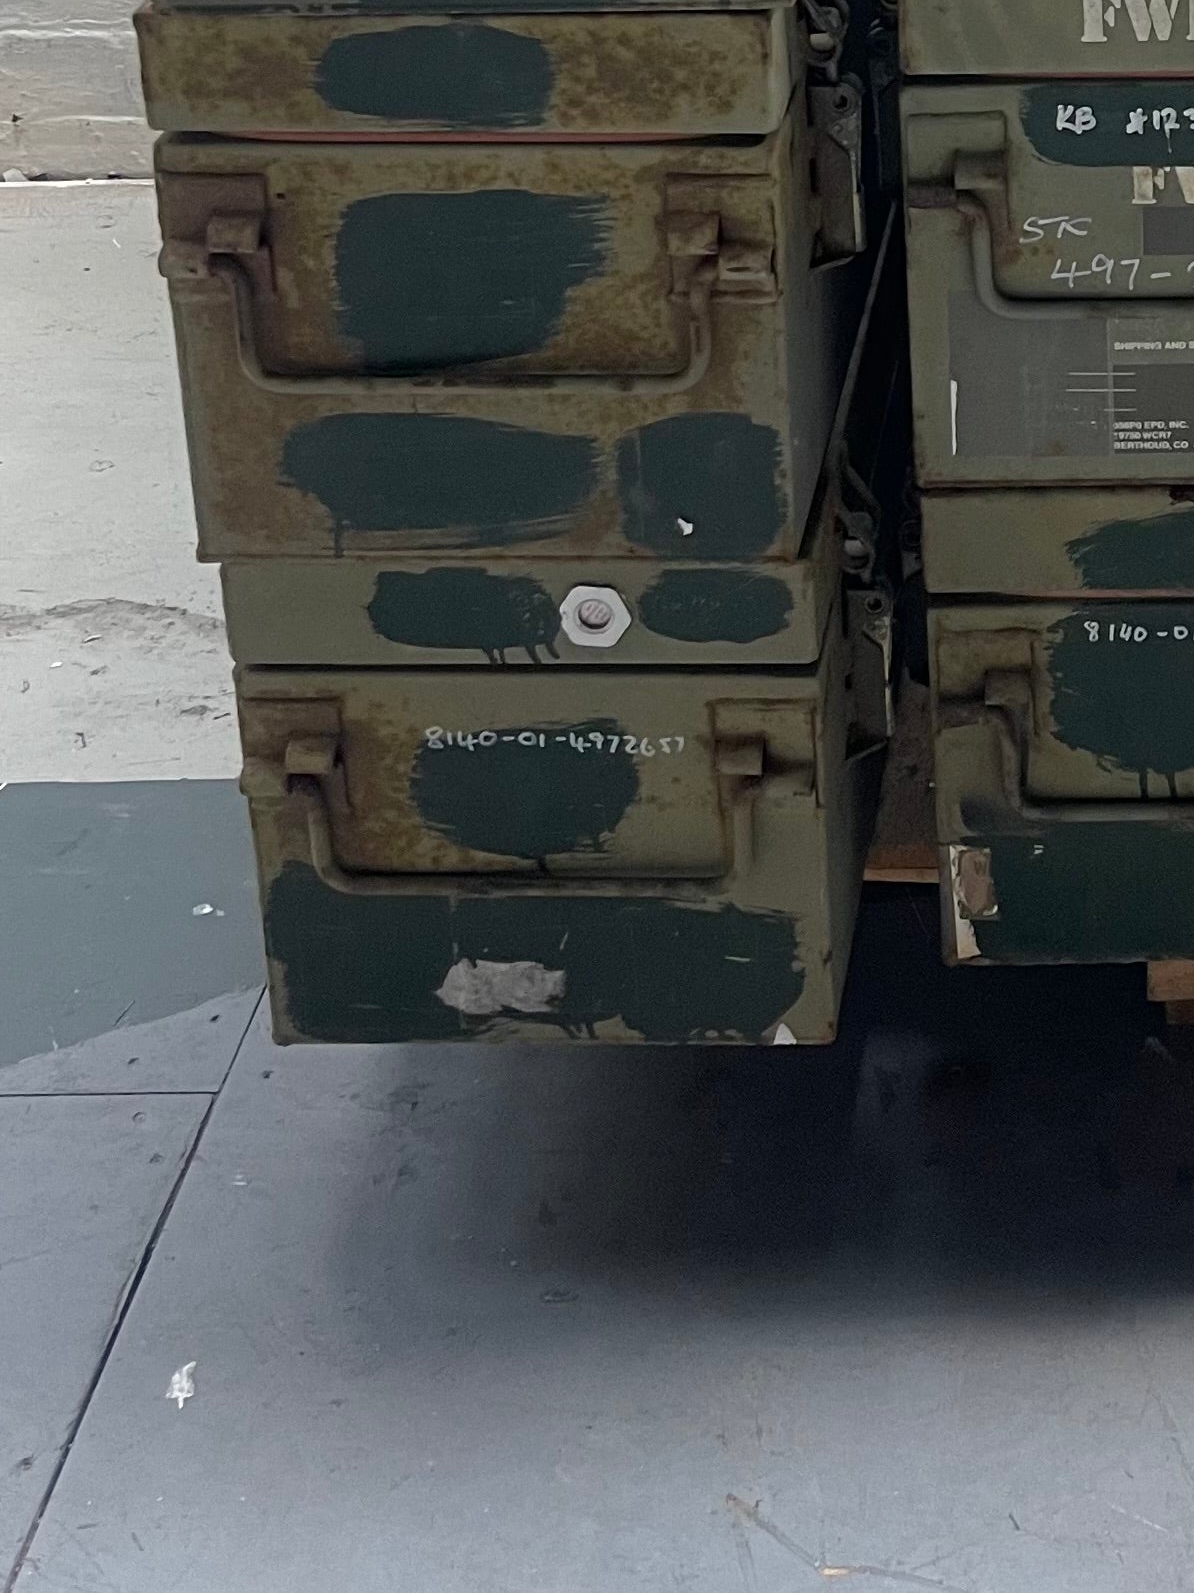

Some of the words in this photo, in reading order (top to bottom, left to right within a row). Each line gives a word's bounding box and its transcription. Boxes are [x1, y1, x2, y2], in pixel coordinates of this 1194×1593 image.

[1055, 104, 1097, 135] KB
[1113, 341, 1162, 351] SHIPPING
[1164, 341, 1187, 350] AND
[1168, 420, 1190, 429] INC.
[1173, 440, 1189, 449] CO
[425, 725, 685, 757] 8140-01-4972657
